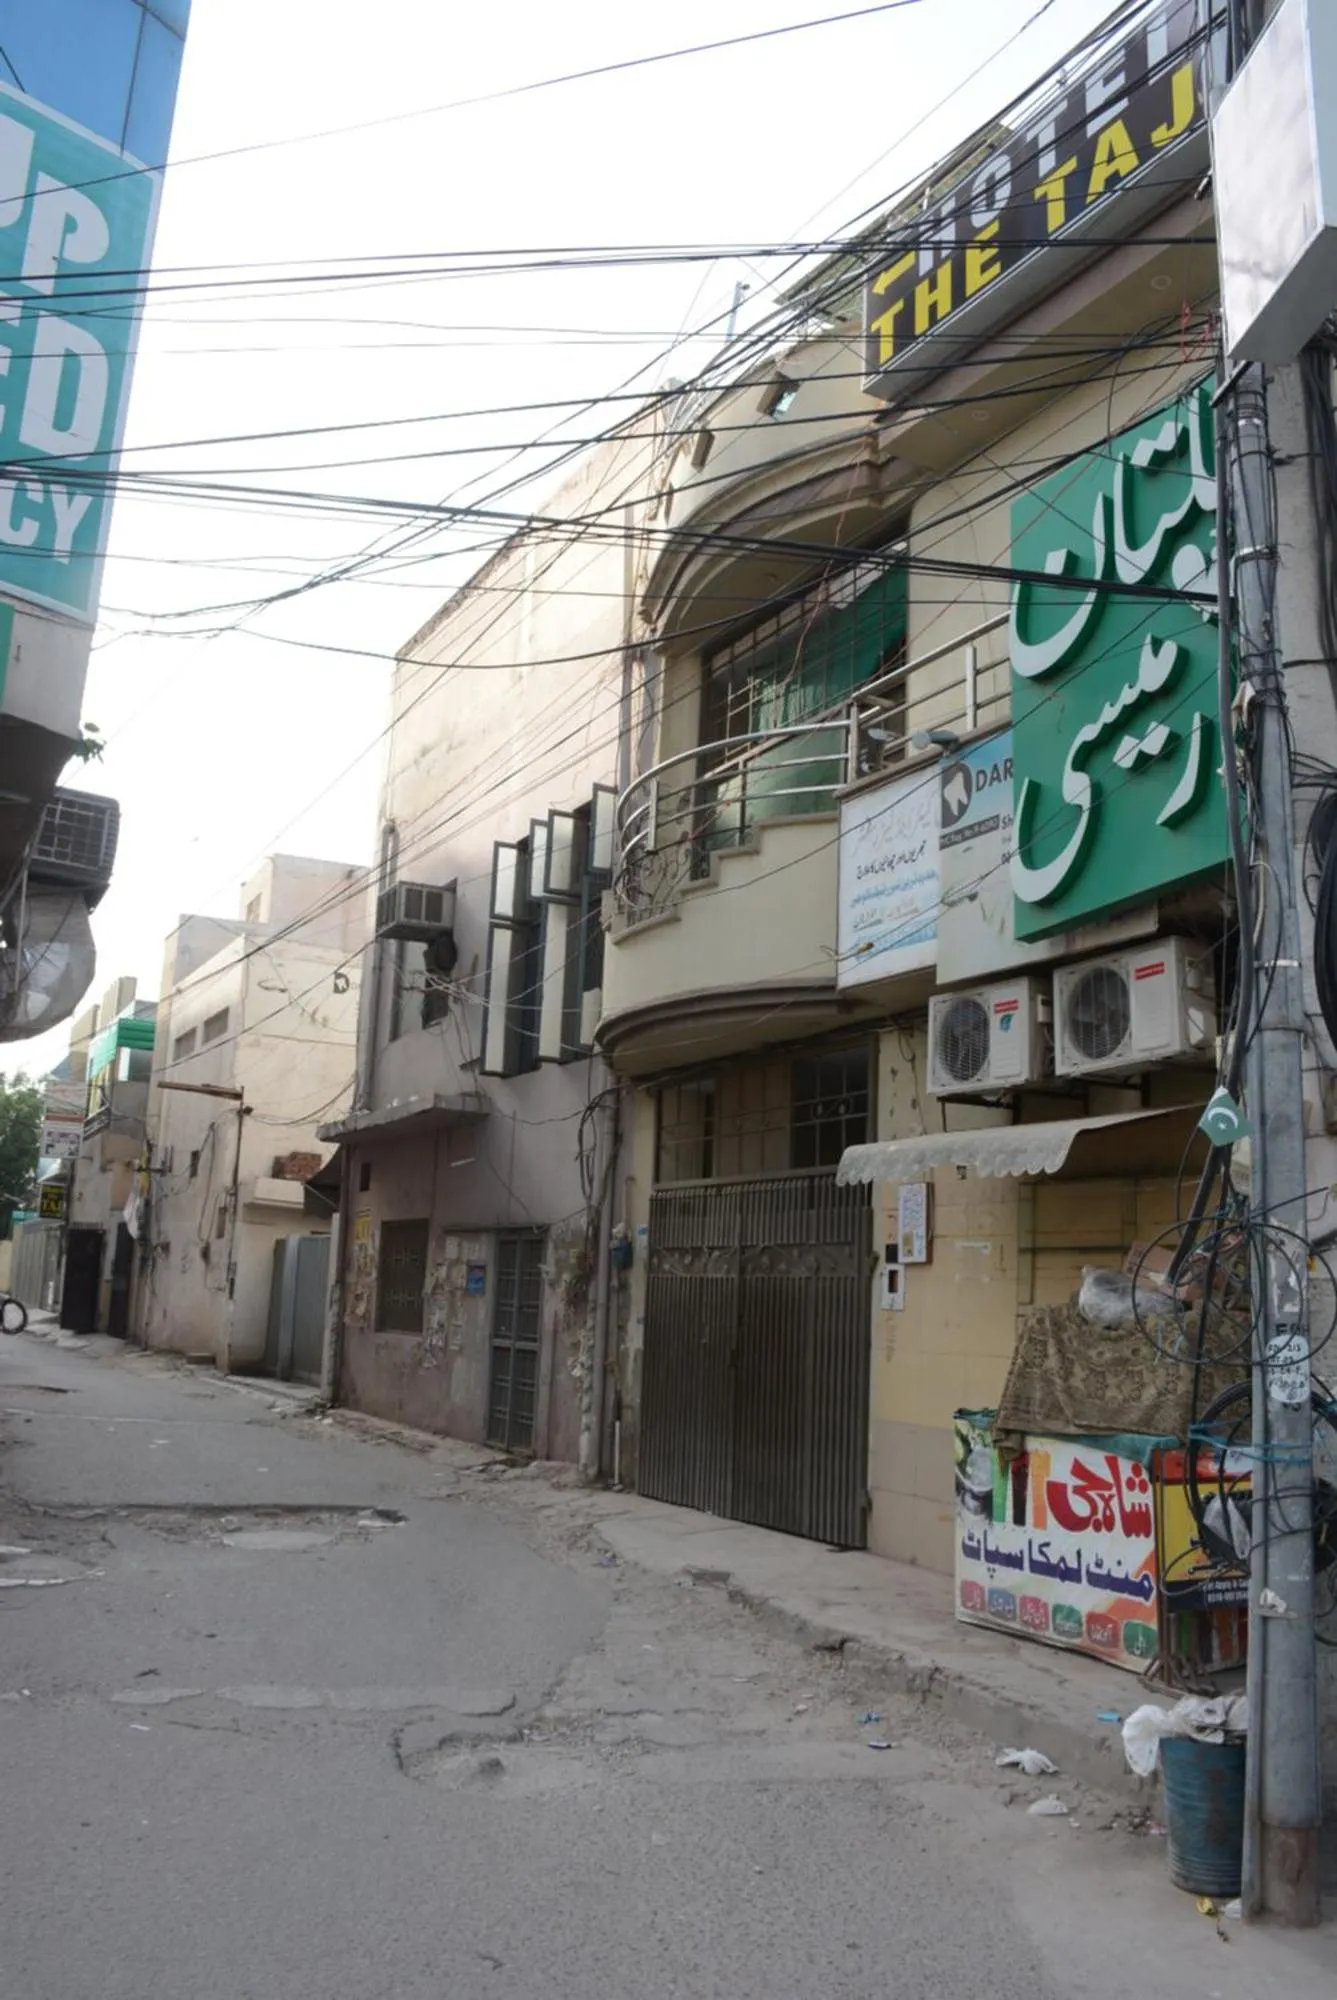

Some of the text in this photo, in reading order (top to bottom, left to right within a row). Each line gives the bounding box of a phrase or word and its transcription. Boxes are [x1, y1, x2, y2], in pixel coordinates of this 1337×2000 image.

[871, 61, 1194, 364] THE TAJ
[919, 12, 1188, 277] HOTEL
[1086, 1553, 1155, 1603] منٹ
